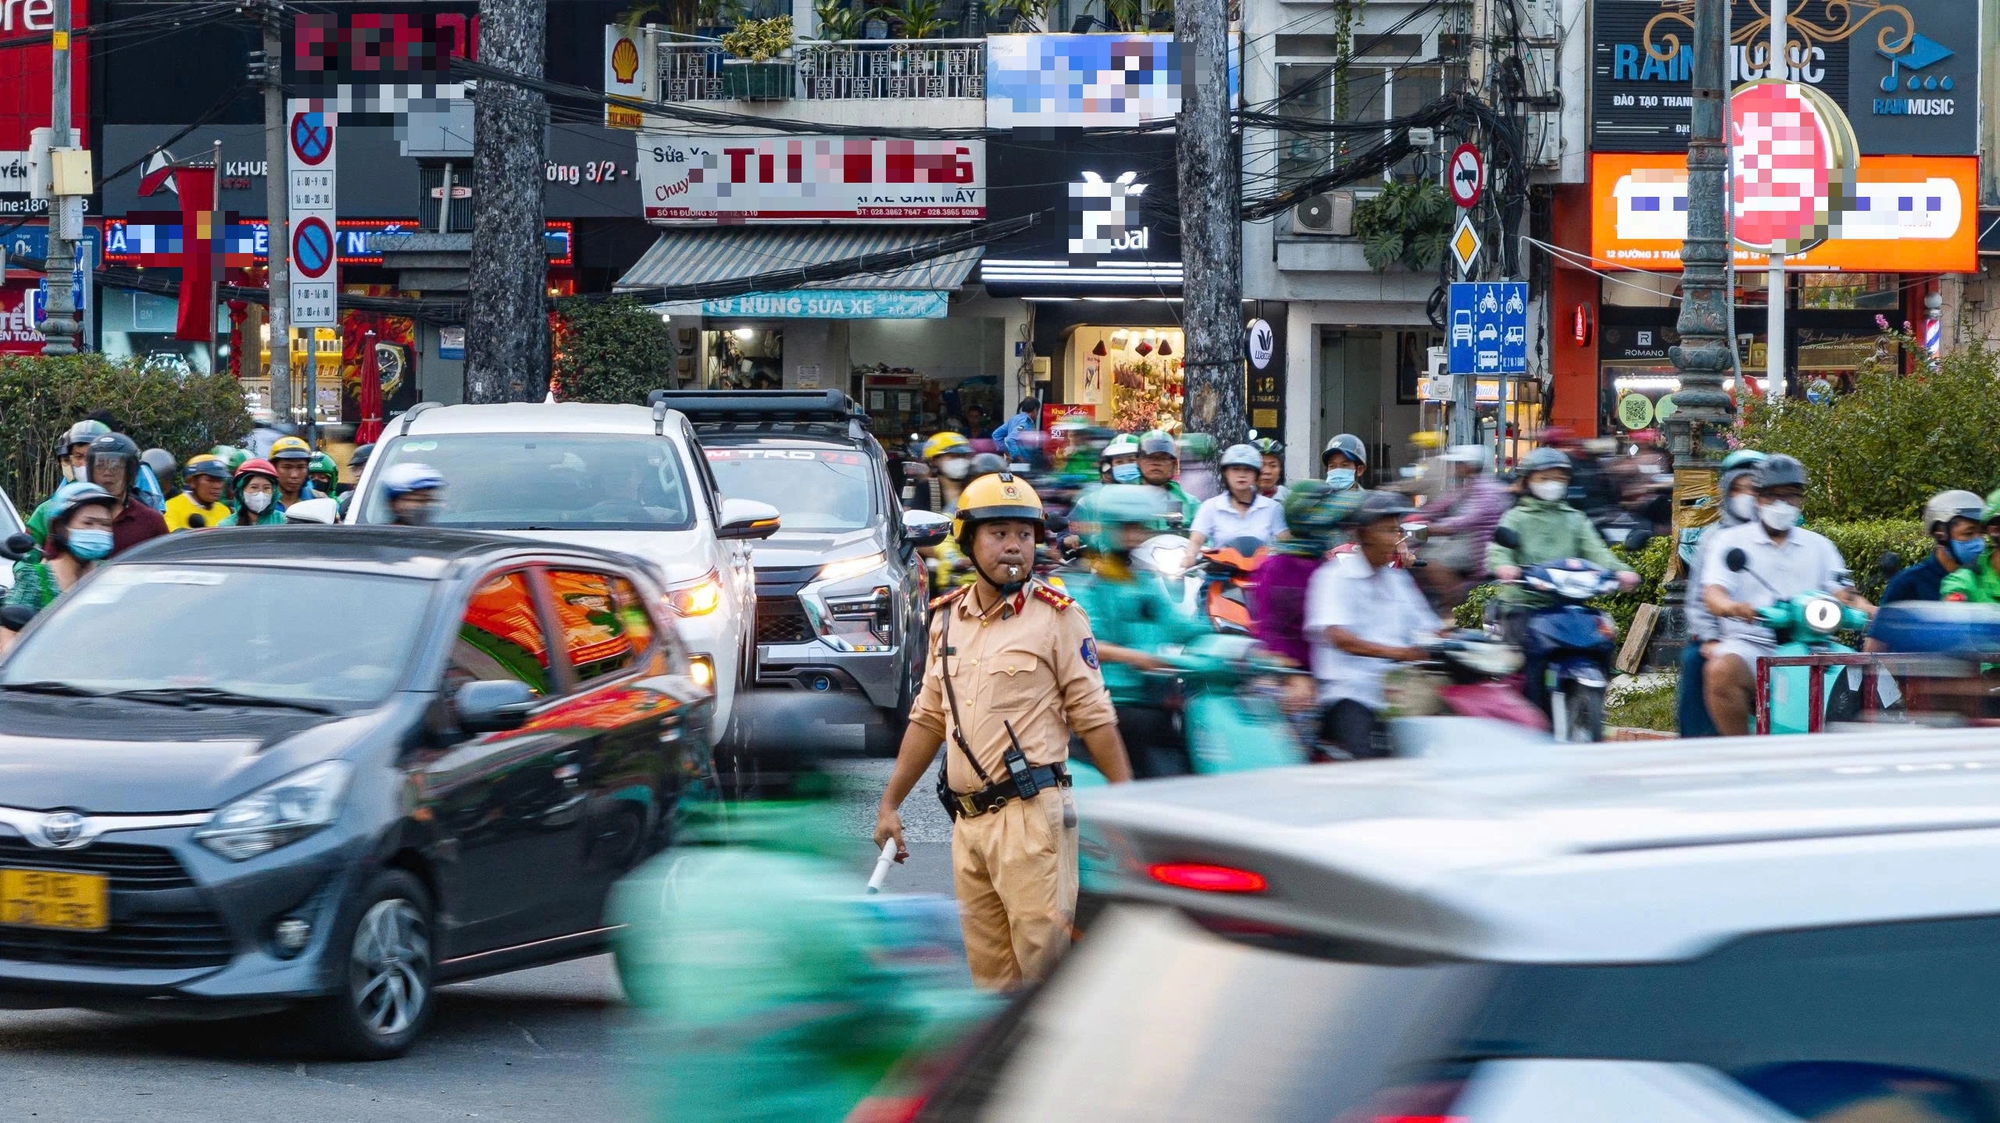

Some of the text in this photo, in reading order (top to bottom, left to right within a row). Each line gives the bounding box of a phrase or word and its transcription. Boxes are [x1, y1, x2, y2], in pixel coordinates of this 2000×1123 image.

[0, 0, 54, 31] re
[1613, 93, 1635, 107] ĐÀO
[1639, 95, 1659, 109] TẠO
[653, 145, 685, 163] Sửa
[585, 161, 615, 182] 3/2
[655, 172, 689, 201] Chuy
[850, 299, 873, 314] XE
[1625, 349, 1664, 357] ROMANO
